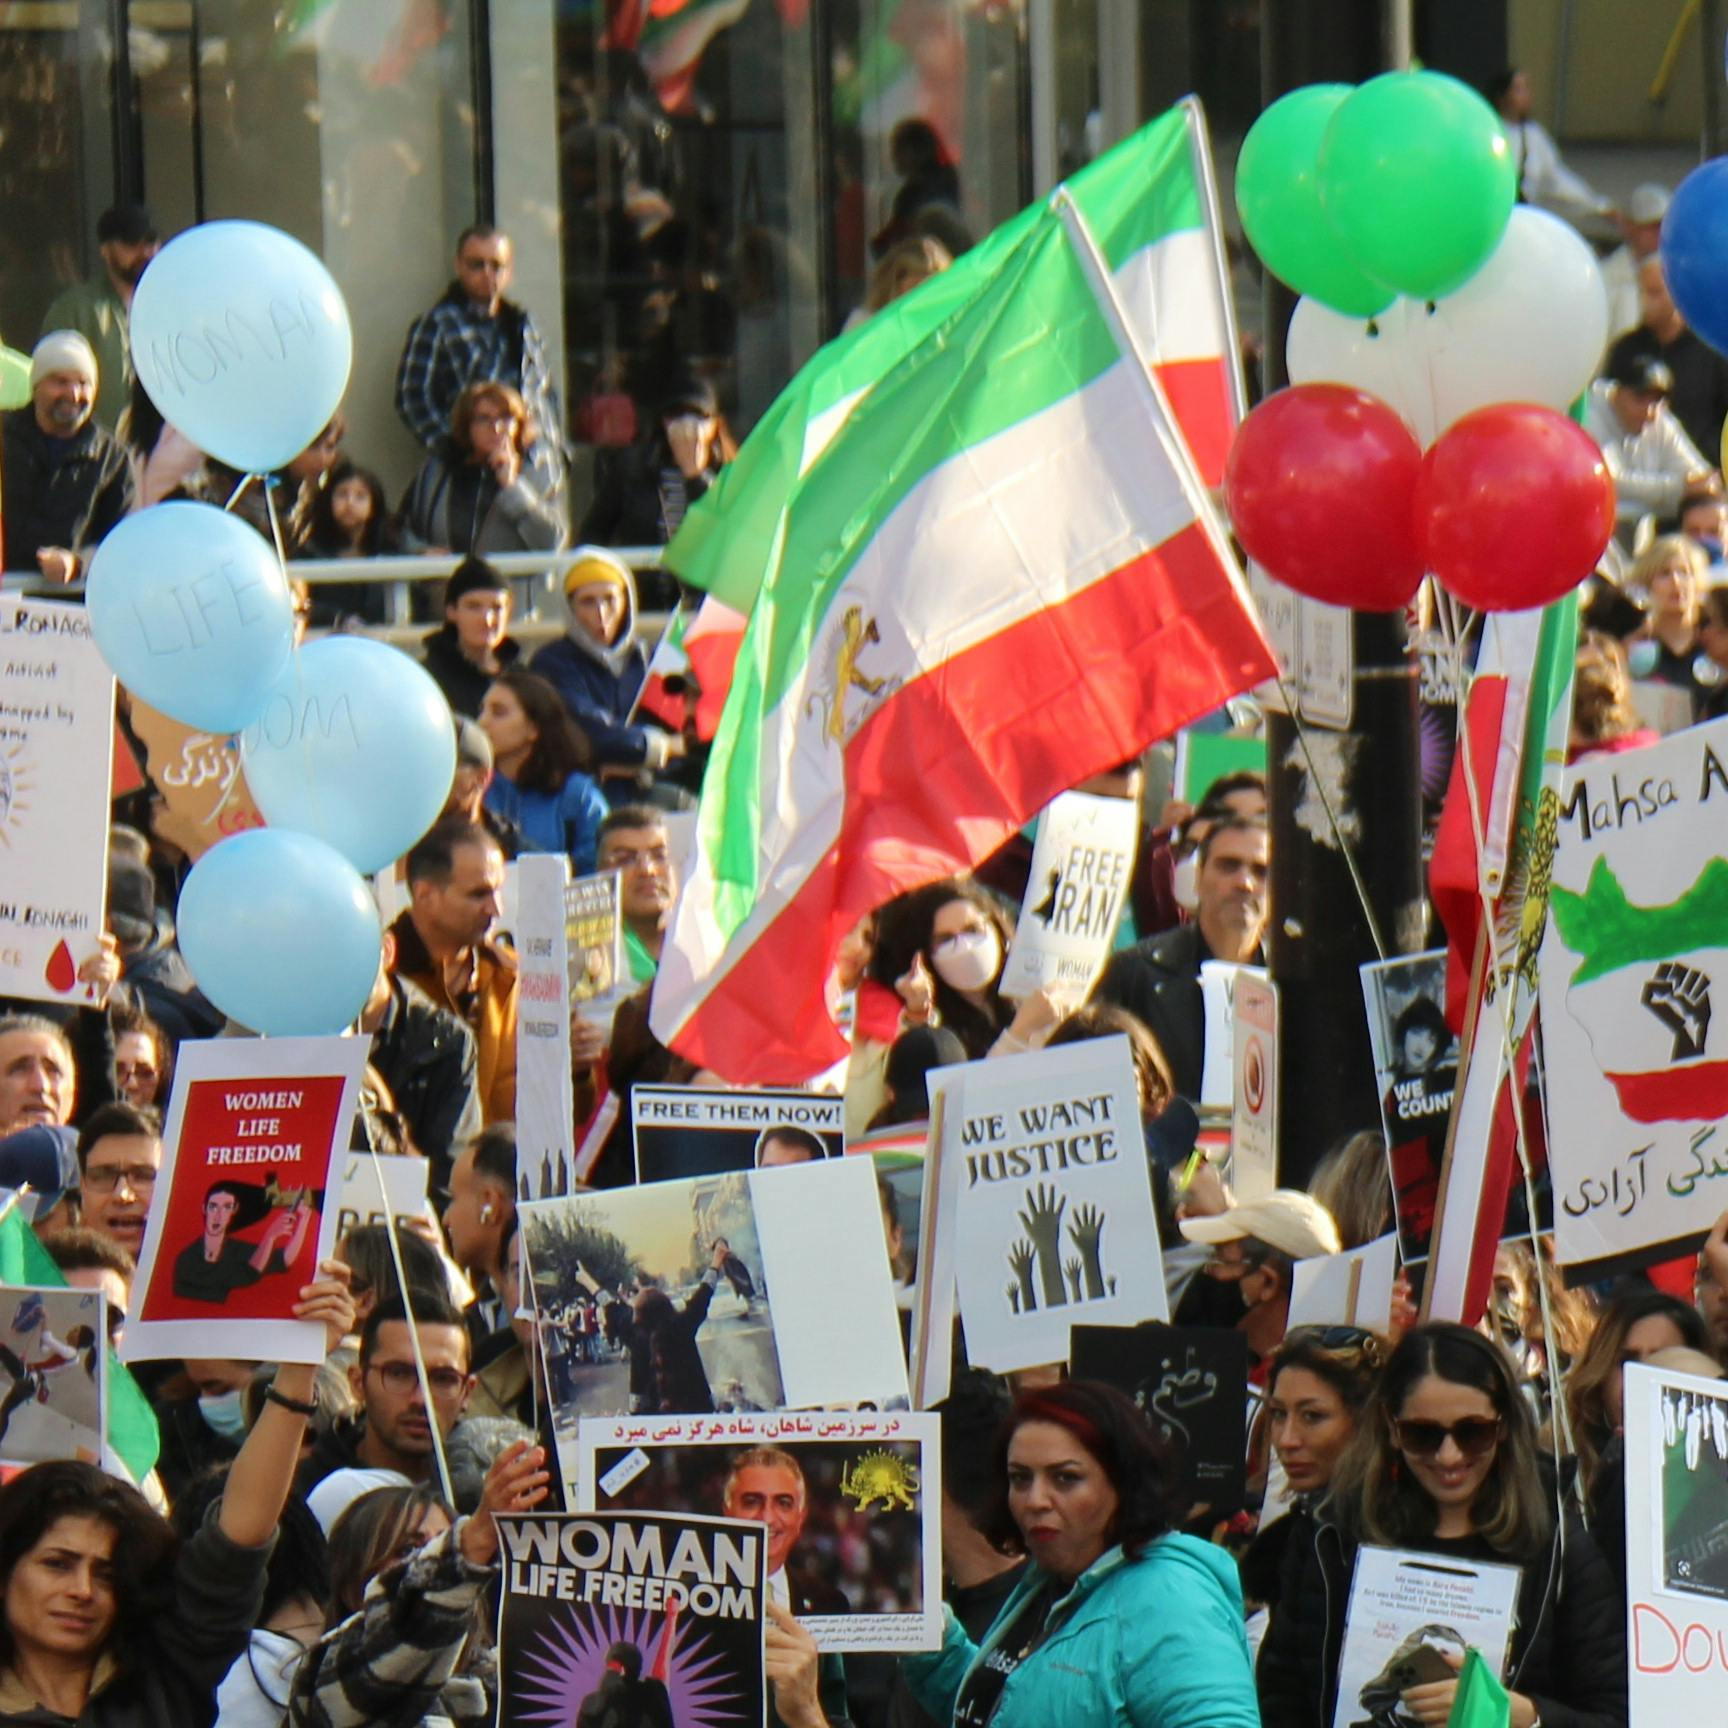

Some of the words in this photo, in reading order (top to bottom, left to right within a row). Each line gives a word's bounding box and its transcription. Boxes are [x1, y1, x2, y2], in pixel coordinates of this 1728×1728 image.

[133, 559, 262, 655] LIFE
[1559, 777, 1679, 841] Mahsa
[1066, 845, 1125, 887] FREE
[224, 1091, 304, 1111] WOMEN
[1392, 1080, 1424, 1099] WE
[638, 1101, 701, 1120] FREE
[706, 1102, 772, 1122] THEM
[777, 1103, 842, 1125] NOW!
[962, 1115, 1007, 1146] WE
[1019, 1094, 1114, 1136] WANT
[237, 1118, 280, 1137] LIFE
[206, 1143, 302, 1166] FREEDOM
[966, 1129, 1118, 1189] JUSTICE
[1562, 1142, 1655, 1218] آزادی
[651, 1420, 682, 1442] نمی
[686, 1420, 726, 1441] هرگز
[728, 1418, 756, 1435] شاه
[816, 1419, 879, 1439] سرزمین
[883, 1418, 901, 1438] در
[502, 1519, 759, 1589] WOMAN
